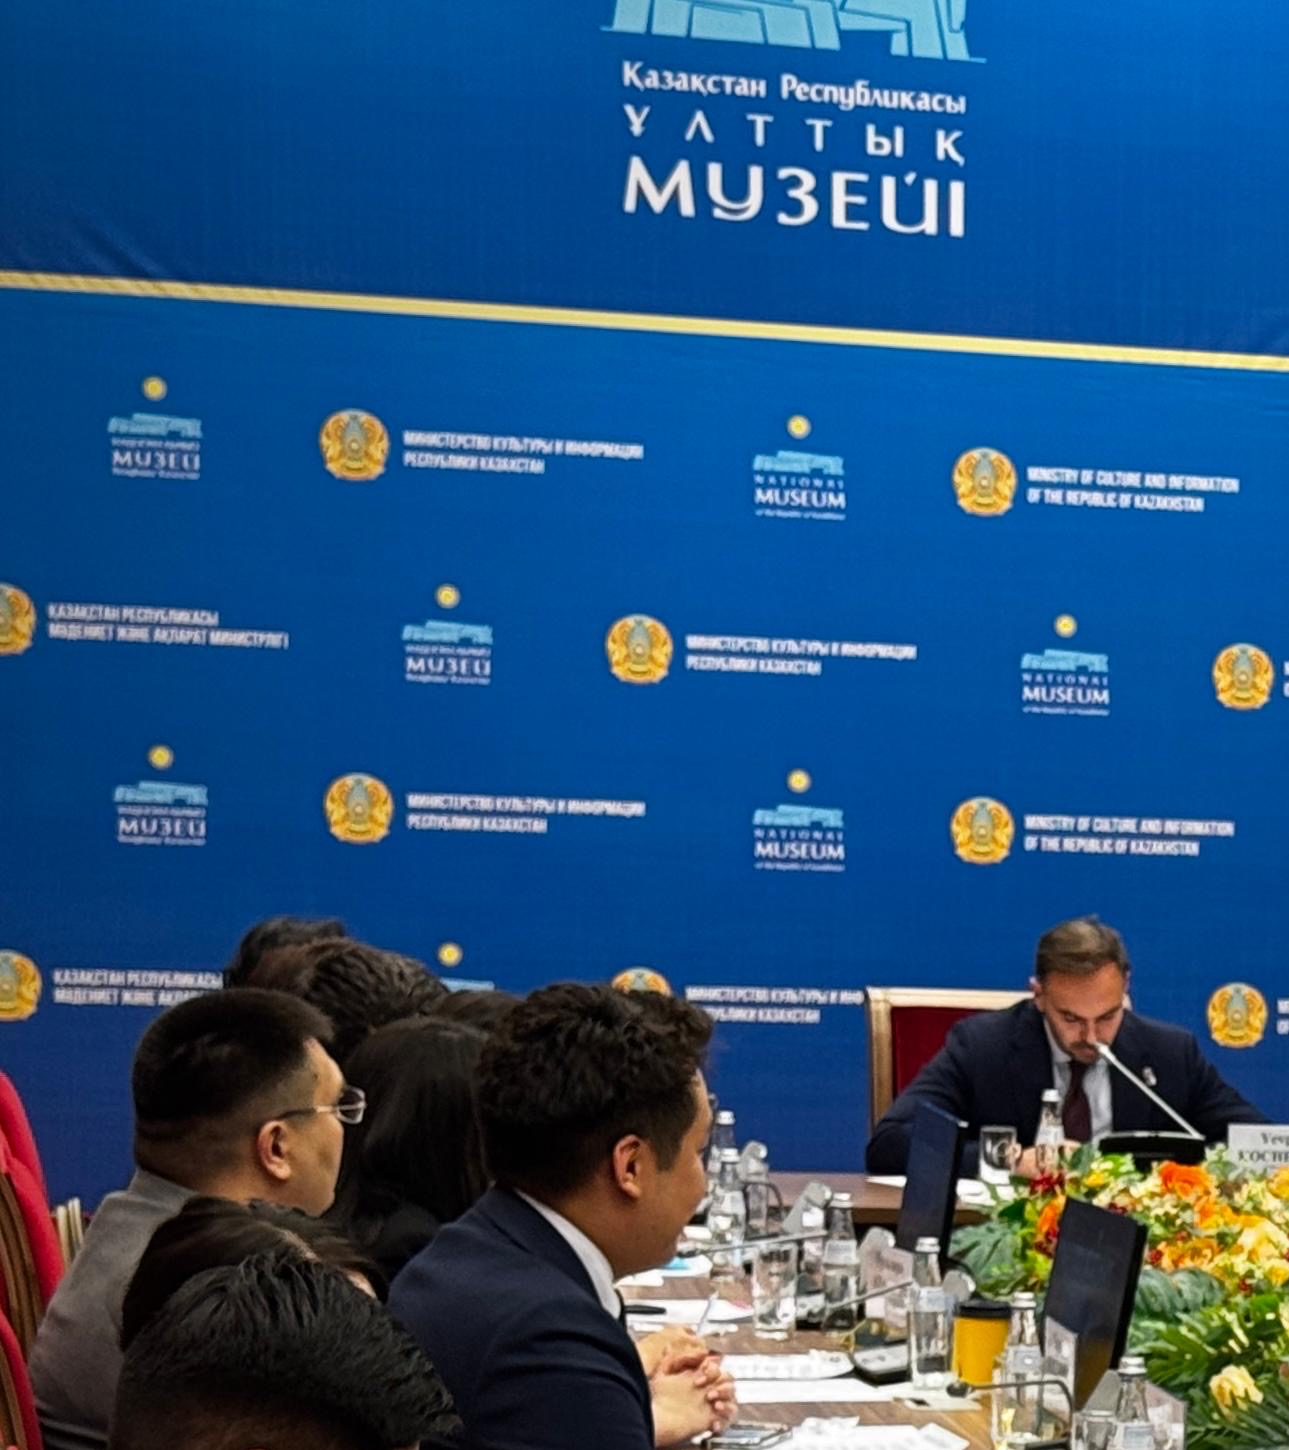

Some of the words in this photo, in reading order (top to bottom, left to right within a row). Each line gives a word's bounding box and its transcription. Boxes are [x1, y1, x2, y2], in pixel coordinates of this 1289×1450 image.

[622, 60, 767, 98] Қазақстан
[779, 73, 967, 115] Республикасы
[1027, 466, 1078, 484] MINISTRY
[1080, 469, 1093, 485] OF
[1096, 470, 1141, 487] CULTURE
[1145, 473, 1166, 489] AND
[1169, 475, 1239, 493] INFORMATION
[755, 488, 846, 510] MUSEUM
[1027, 487, 1041, 504] OF
[1044, 488, 1063, 505] THE
[1066, 489, 1117, 508] REPUBLIC
[1119, 493, 1132, 508] OF
[1134, 494, 1204, 512] KAZAKHSTAN
[1022, 685, 1110, 706] MUSEUM
[1024, 815, 1075, 832] MINISTRY
[1077, 817, 1090, 832] OF
[1092, 817, 1137, 834] CULTURE
[1139, 819, 1162, 835] AND
[1164, 820, 1235, 837] INFORMATION
[754, 841, 846, 861] MUSEUM
[1024, 835, 1038, 851] OF
[1040, 836, 1060, 852] THE
[1062, 837, 1113, 854] REPUBLIC
[1115, 839, 1128, 855] OF
[1130, 839, 1200, 857] KAZAKHSTAN
[1276, 1020, 1289, 1035] OF
